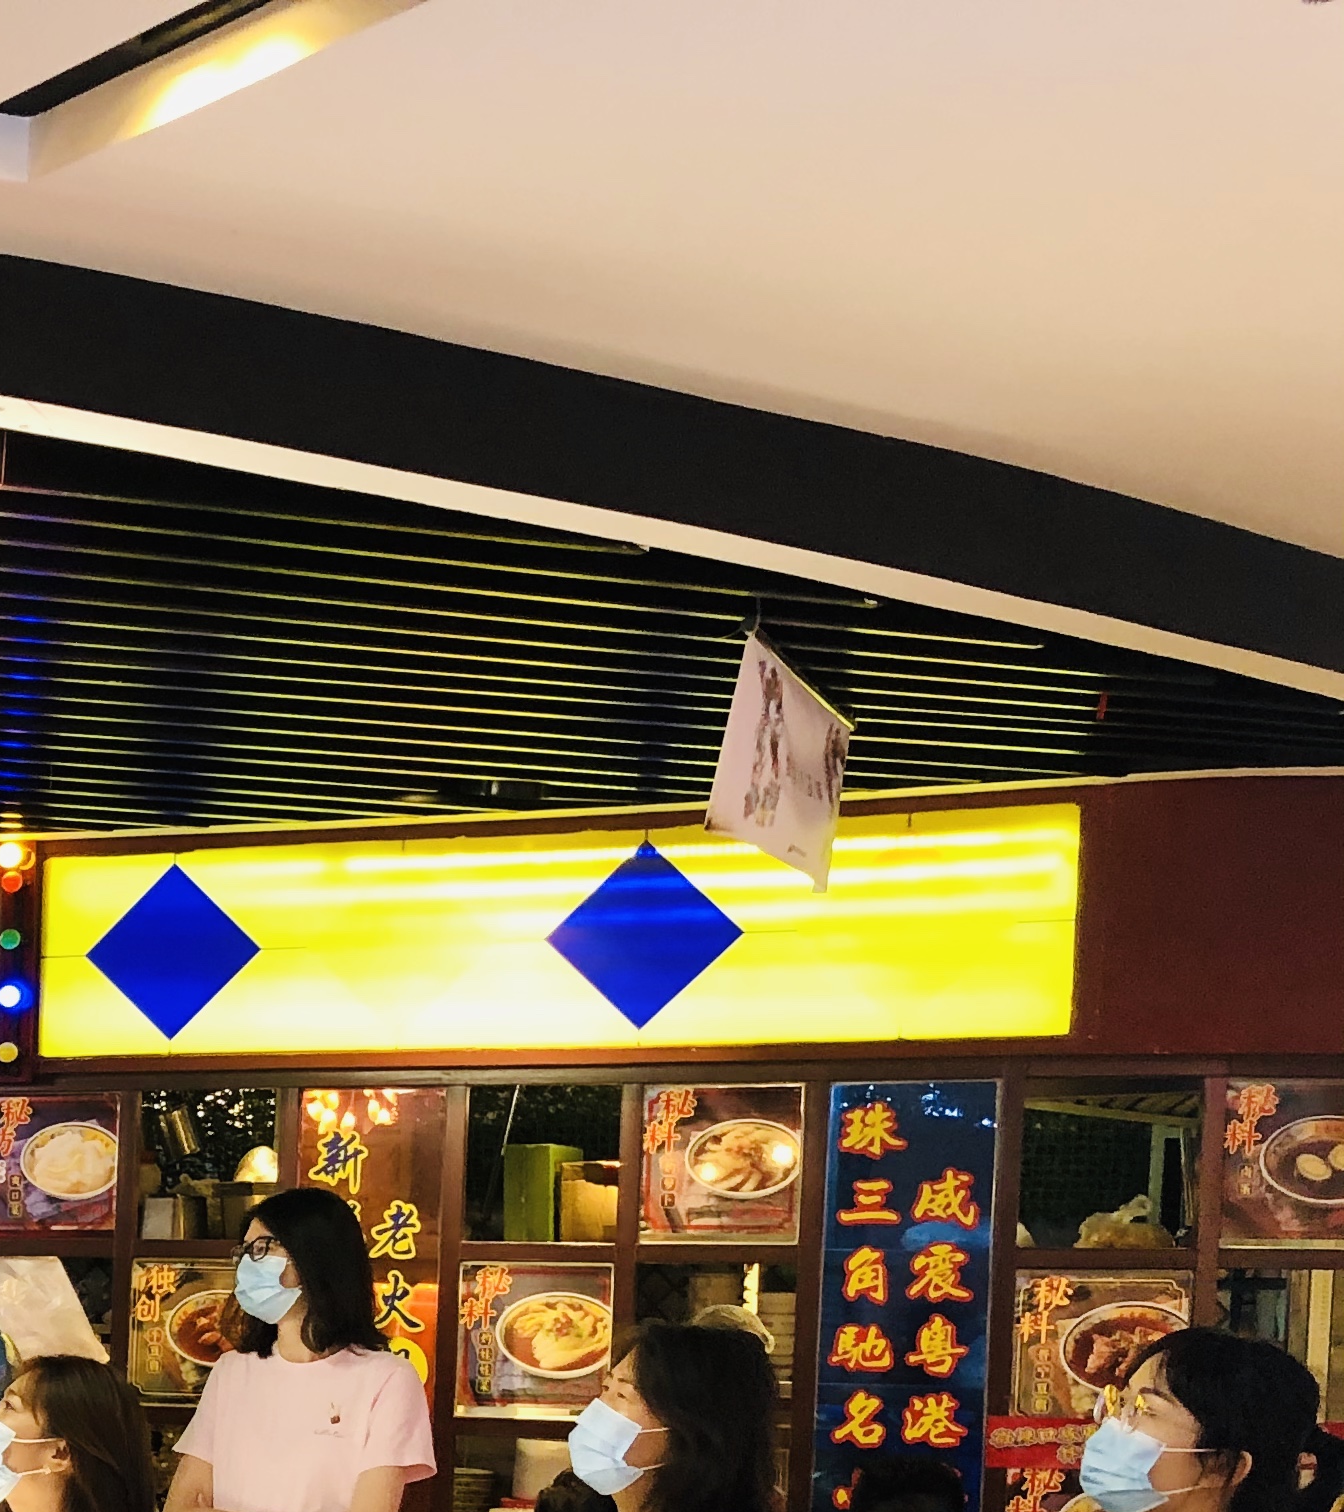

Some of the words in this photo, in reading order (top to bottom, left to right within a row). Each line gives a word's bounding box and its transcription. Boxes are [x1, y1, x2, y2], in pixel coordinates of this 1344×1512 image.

[643, 1088, 697, 1155] 秘料
[1223, 1084, 1280, 1155] 秘料
[135, 1264, 177, 1323] 独创
[458, 1264, 512, 1330] 秘料
[1015, 1276, 1073, 1344] 秘料
[900, 1167, 981, 1502] 威震粵港
